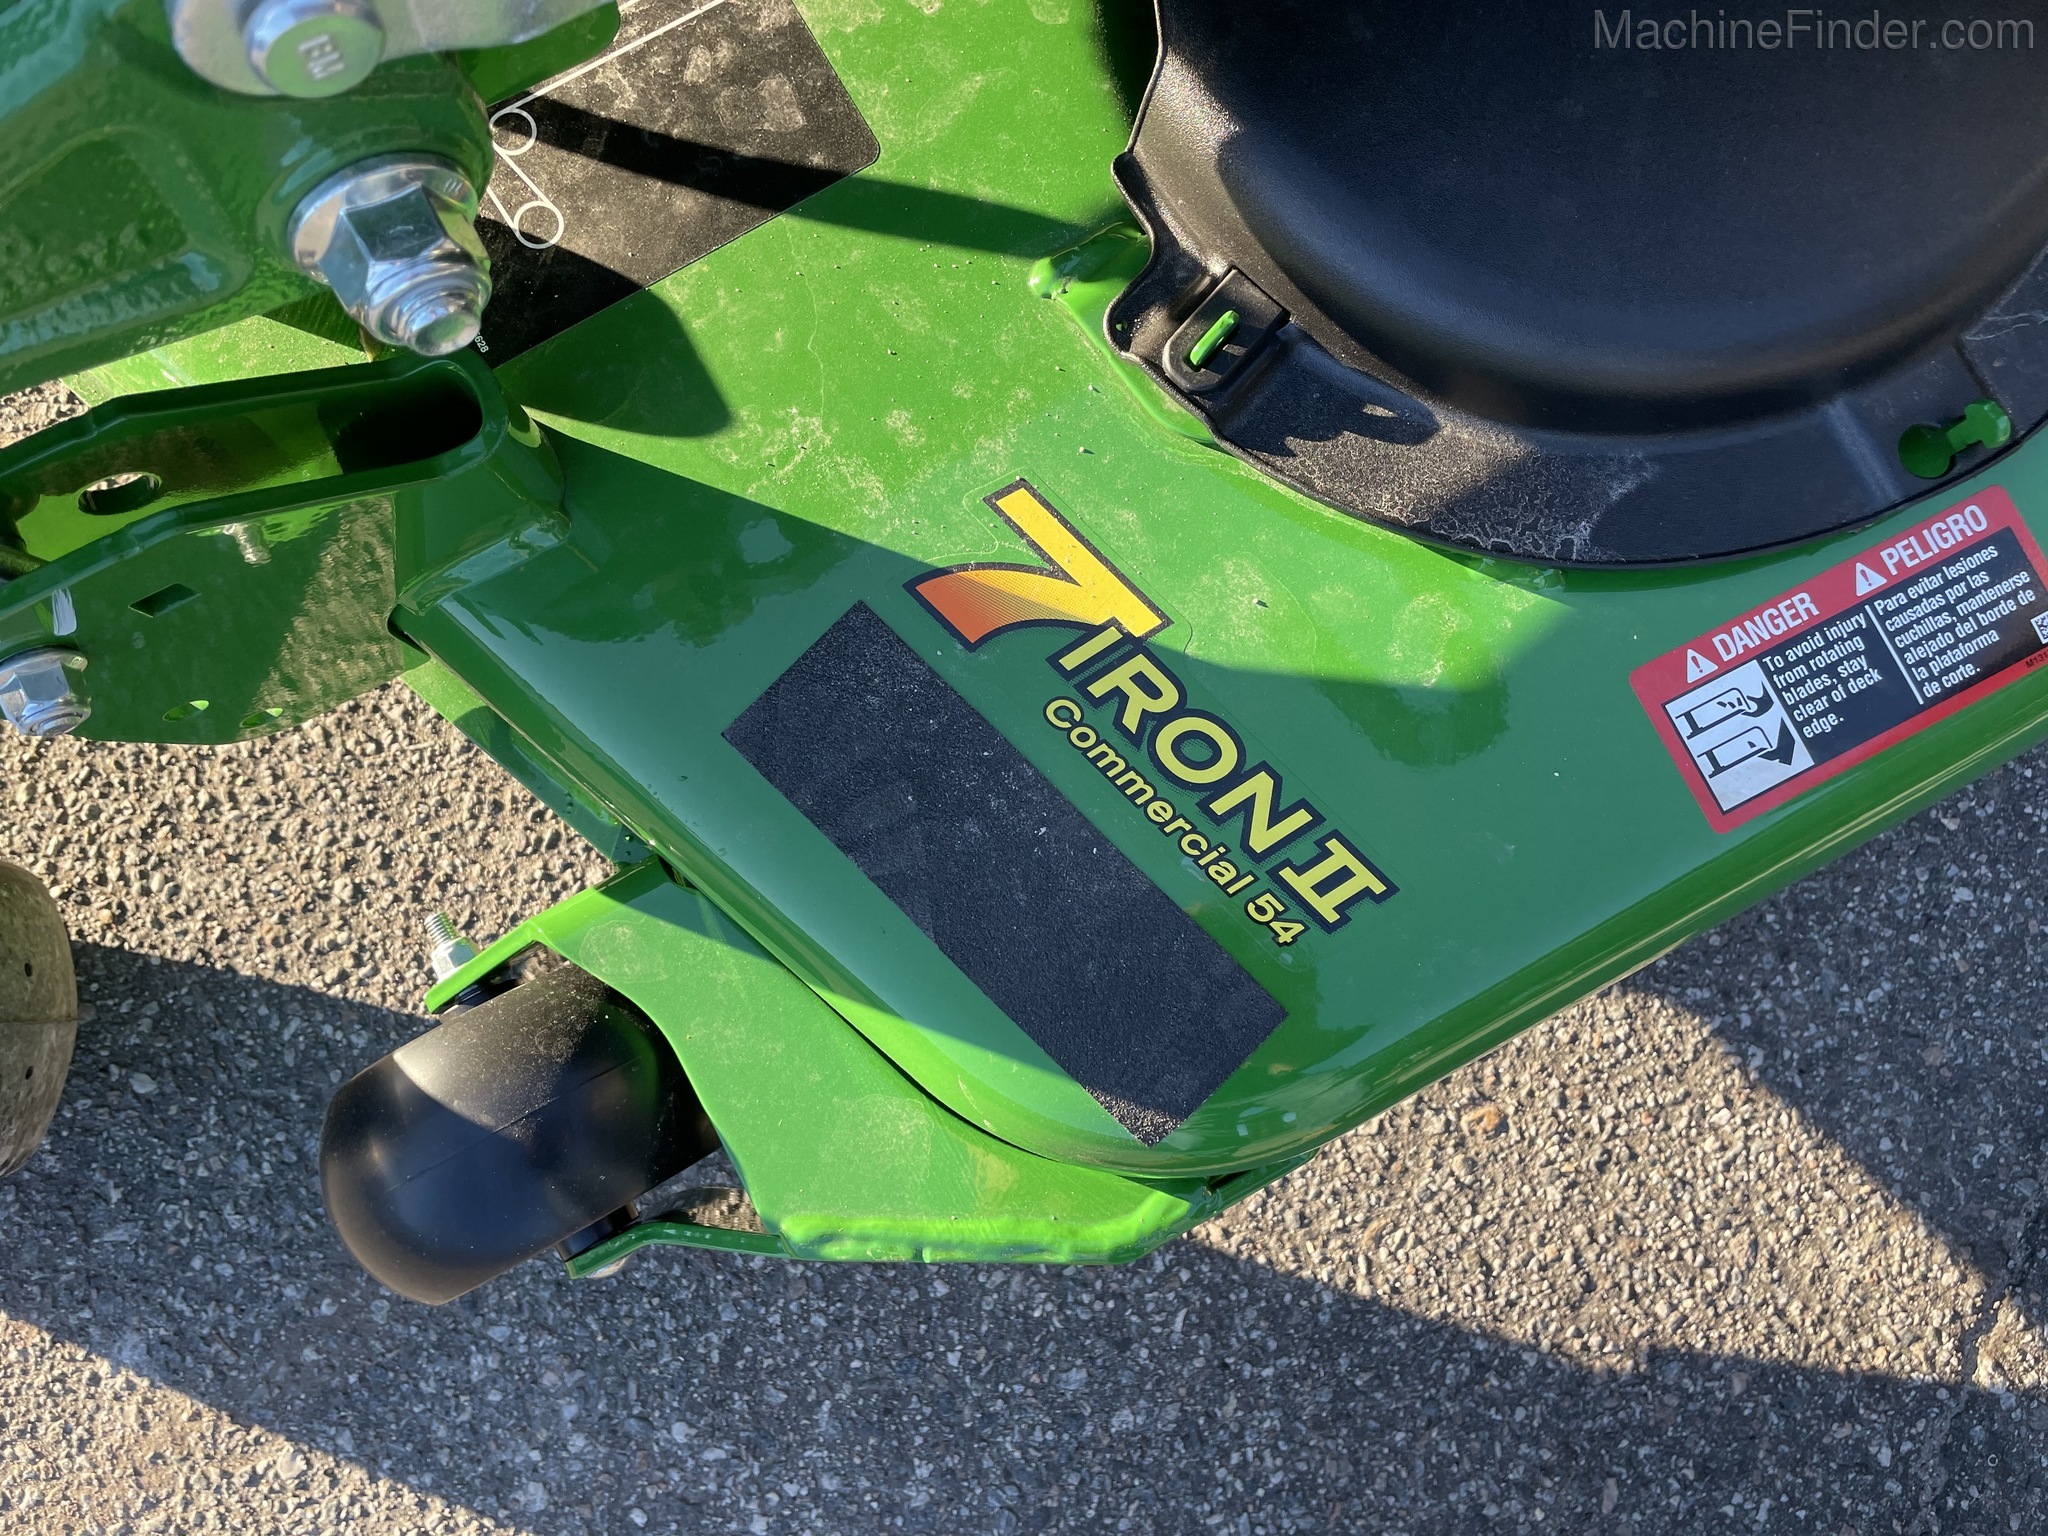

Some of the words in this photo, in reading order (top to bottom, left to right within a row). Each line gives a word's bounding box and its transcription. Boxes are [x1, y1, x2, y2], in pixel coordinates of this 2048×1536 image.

[474, 331, 489, 353] 628
[1880, 505, 1988, 575] PELIGRO
[1874, 592, 1907, 615] Para
[1907, 572, 1944, 599] evitar
[1942, 545, 1998, 580] lesiones
[1885, 594, 1945, 631] causadas
[1945, 581, 1968, 604] por
[1966, 570, 1989, 588] las
[1894, 611, 1957, 648] cuchillas,
[1956, 571, 2030, 616] mantenerse
[1712, 592, 1820, 662] DANGER
[1763, 657, 1784, 672] To
[1786, 632, 1825, 661] avoid
[1824, 613, 1867, 642] injury
[1904, 631, 1954, 665] alejado
[1955, 616, 1978, 638] del
[1976, 598, 2017, 626] borde
[2017, 588, 2036, 606] de
[1912, 664, 1929, 681] la
[1929, 629, 2000, 676] plataforma
[1773, 664, 1808, 689] from
[1809, 635, 1865, 671] rotating
[1782, 673, 1837, 705] blades,
[1838, 655, 1868, 678] stay
[1923, 681, 1941, 698] de
[1942, 662, 1981, 688] corte.
[1793, 695, 1830, 722] clear
[1831, 685, 1848, 702] of
[1848, 668, 1882, 694] deck
[1802, 711, 1844, 738] edge.
[1052, 622, 1320, 858] IRON
[1272, 834, 1394, 929] II
[1044, 697, 1257, 897] Commercial
[1246, 890, 1308, 946] 54
